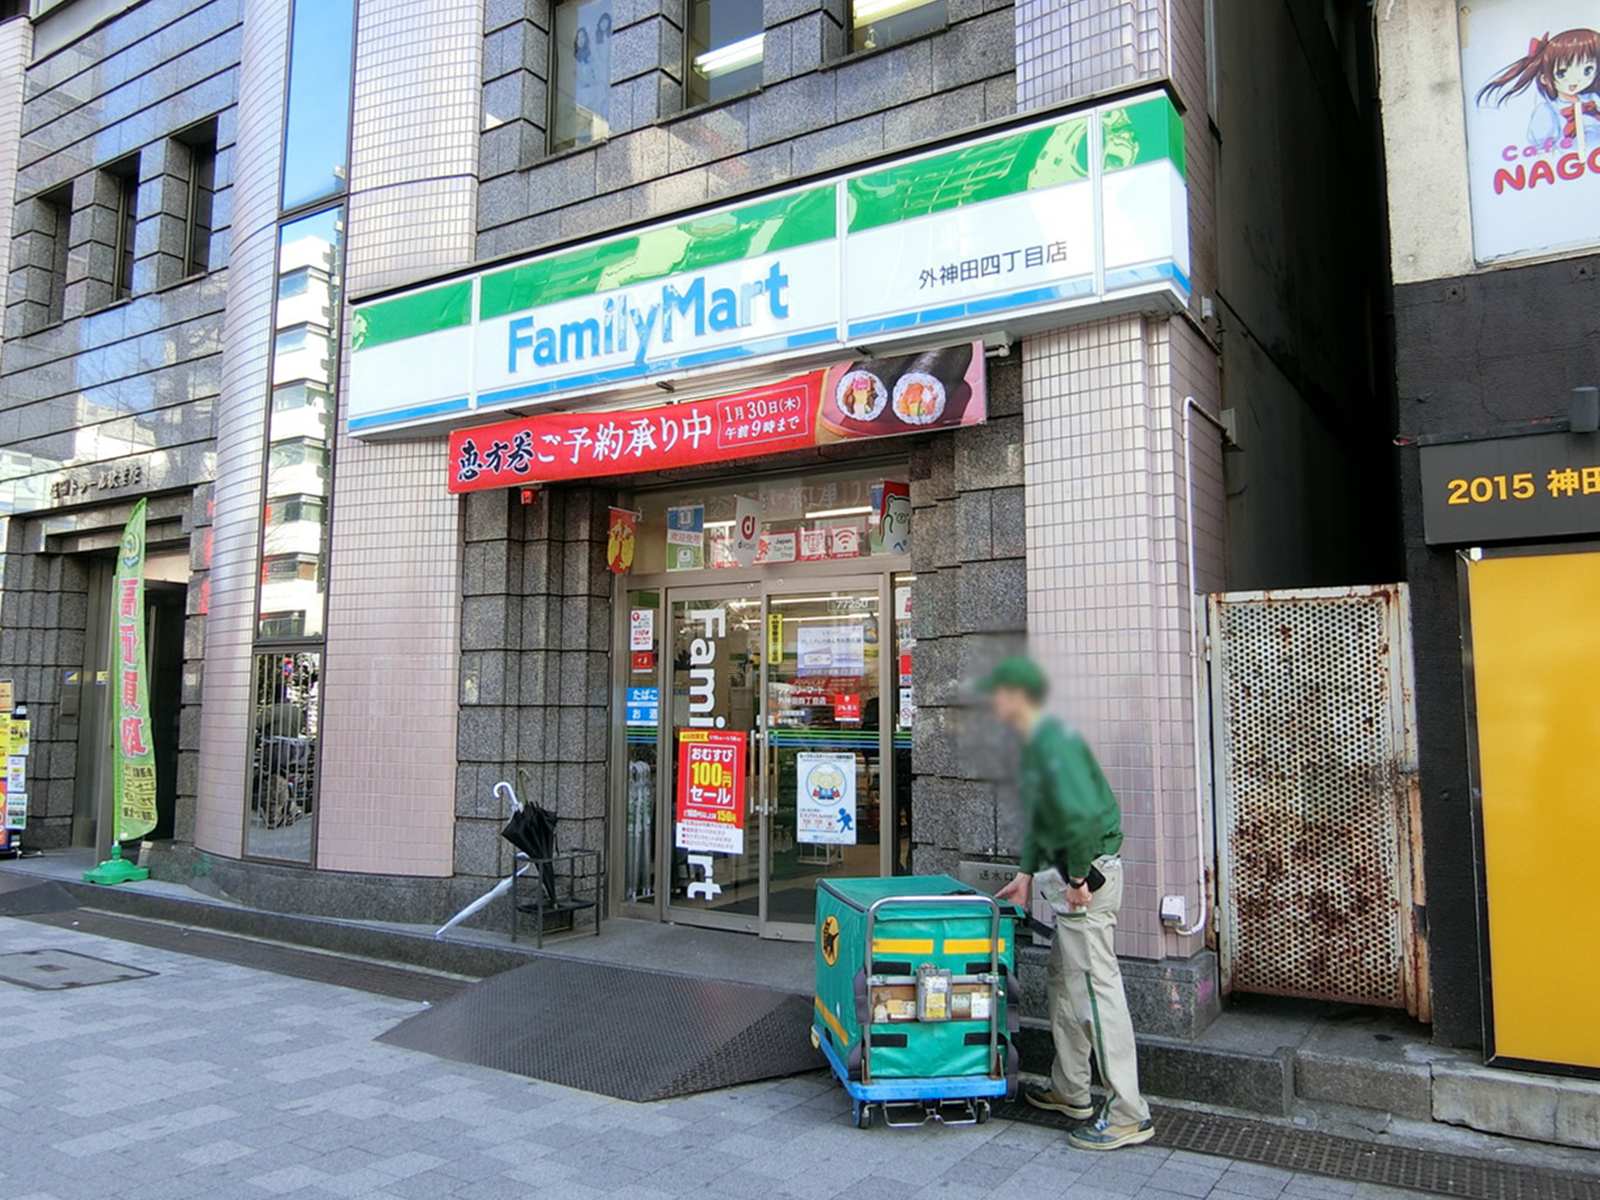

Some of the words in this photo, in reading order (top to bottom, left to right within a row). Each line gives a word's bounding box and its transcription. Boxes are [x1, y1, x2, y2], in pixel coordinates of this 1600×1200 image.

[919, 241, 1067, 290] 外神田四丁目店
[508, 261, 789, 374] FamilyMart
[725, 396, 801, 424] 1月30日(木)
[725, 415, 800, 441] 午前9時まで
[458, 430, 534, 482] 恵方巻
[537, 409, 712, 464] ご予約承り中
[1447, 473, 1535, 504] 2015
[632, 689, 658, 700] たばこ
[691, 748, 733, 762] おむすび
[691, 761, 732, 788] 100円
[690, 786, 731, 804] セール
[980, 869, 1014, 881] 送水口
